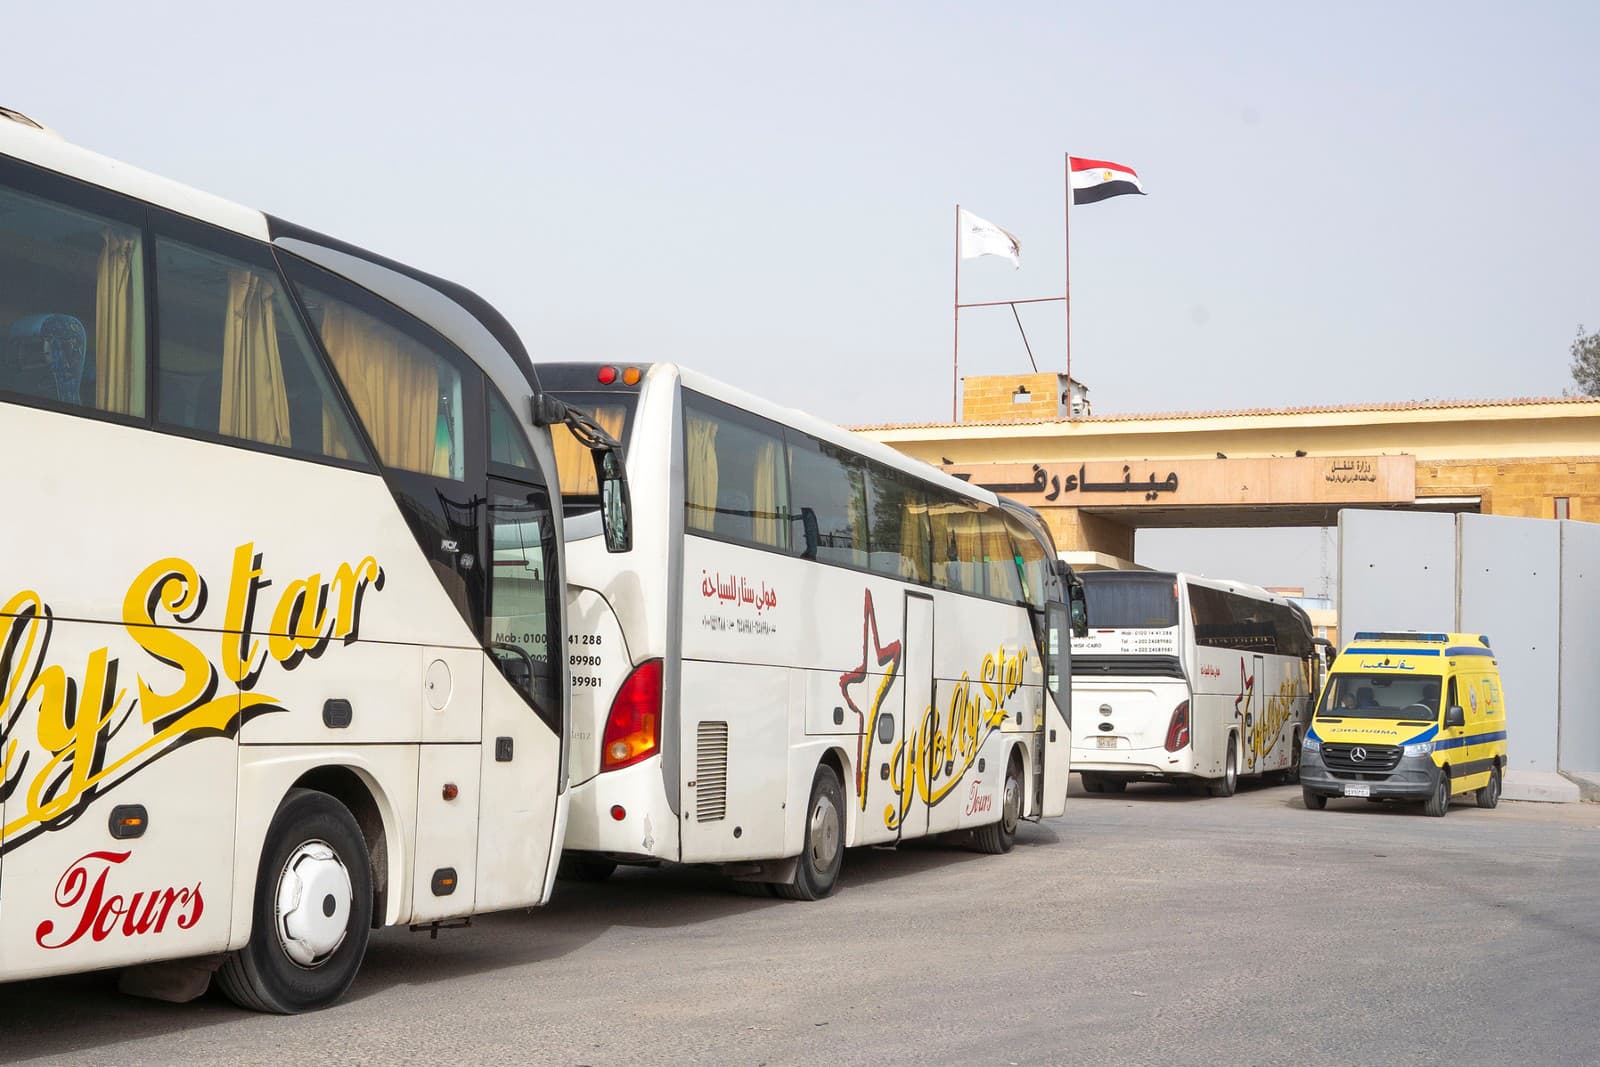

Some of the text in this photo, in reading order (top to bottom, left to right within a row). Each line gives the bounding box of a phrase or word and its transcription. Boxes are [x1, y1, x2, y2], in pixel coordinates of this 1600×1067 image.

[1064, 462, 1179, 501] ميناء
[122, 541, 385, 733] Star
[582, 634, 602, 645] 288
[965, 779, 993, 816] Tours
[35, 850, 205, 950] Tours
